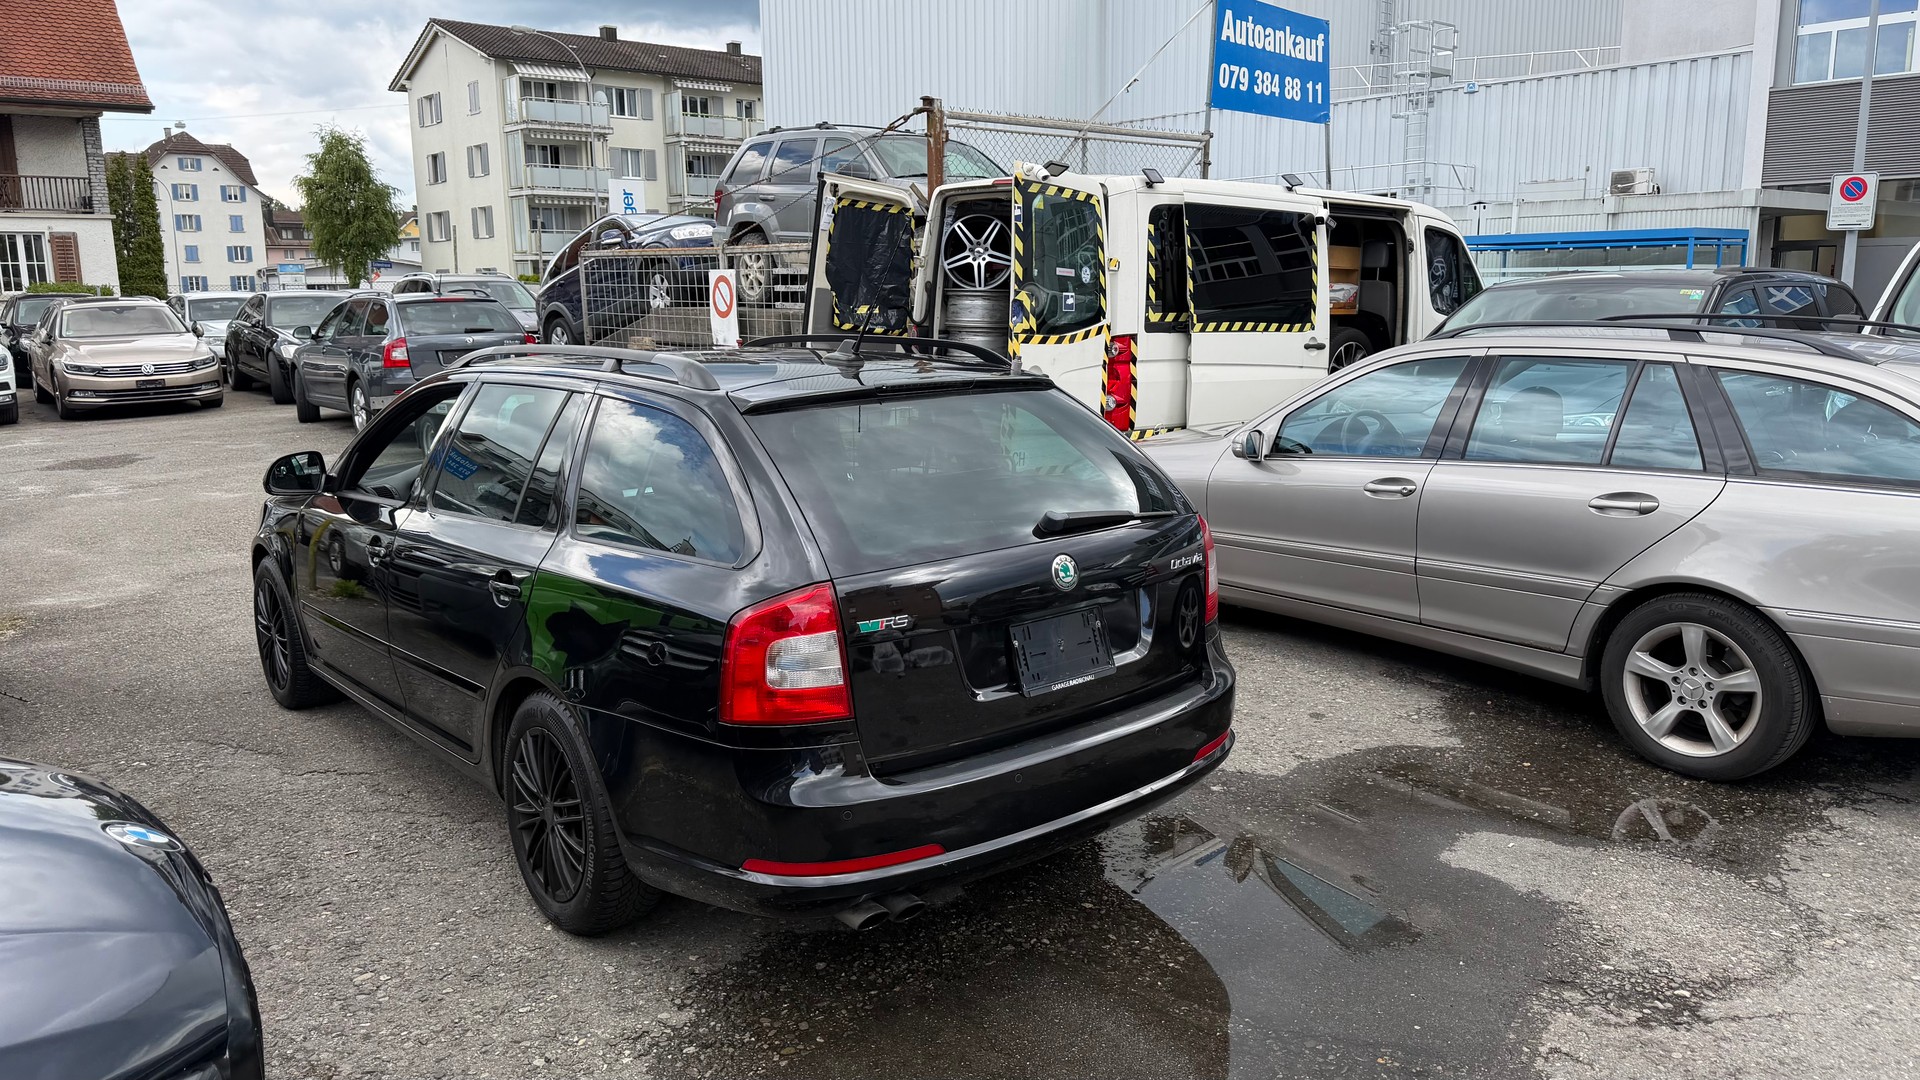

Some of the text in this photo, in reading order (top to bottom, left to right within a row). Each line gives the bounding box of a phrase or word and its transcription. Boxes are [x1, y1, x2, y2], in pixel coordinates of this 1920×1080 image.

[1221, 9, 1325, 63] Autoankauf
[1219, 63, 1322, 104] 079 384 88 11
[1012, 451, 1026, 467] CH
[1170, 552, 1203, 570] Octavia
[1707, 609, 1758, 646] BRAVURIS
